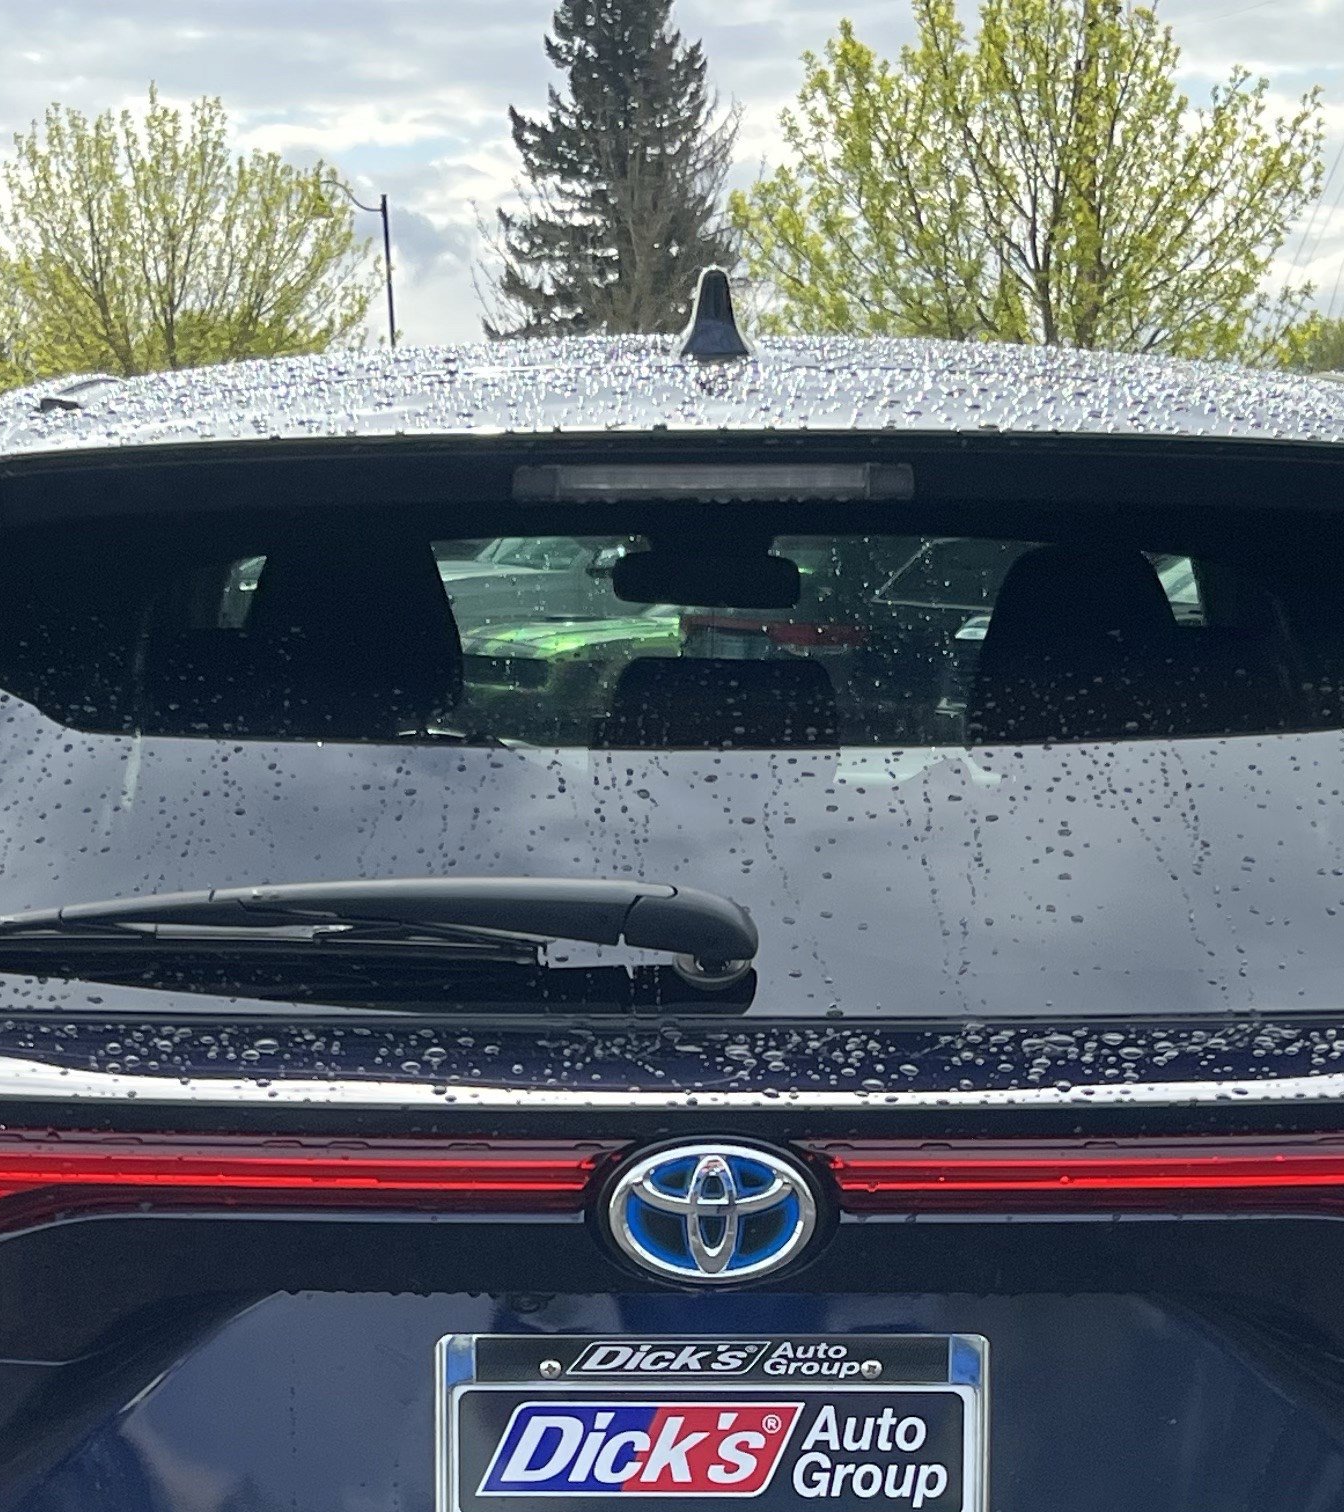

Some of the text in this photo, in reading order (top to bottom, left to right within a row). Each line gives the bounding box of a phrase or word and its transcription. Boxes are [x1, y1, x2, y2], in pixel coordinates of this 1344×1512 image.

[771, 1341, 848, 1359] Auto
[762, 1357, 861, 1378] Group
[801, 1405, 927, 1452] Auto
[792, 1452, 948, 1508] Group
